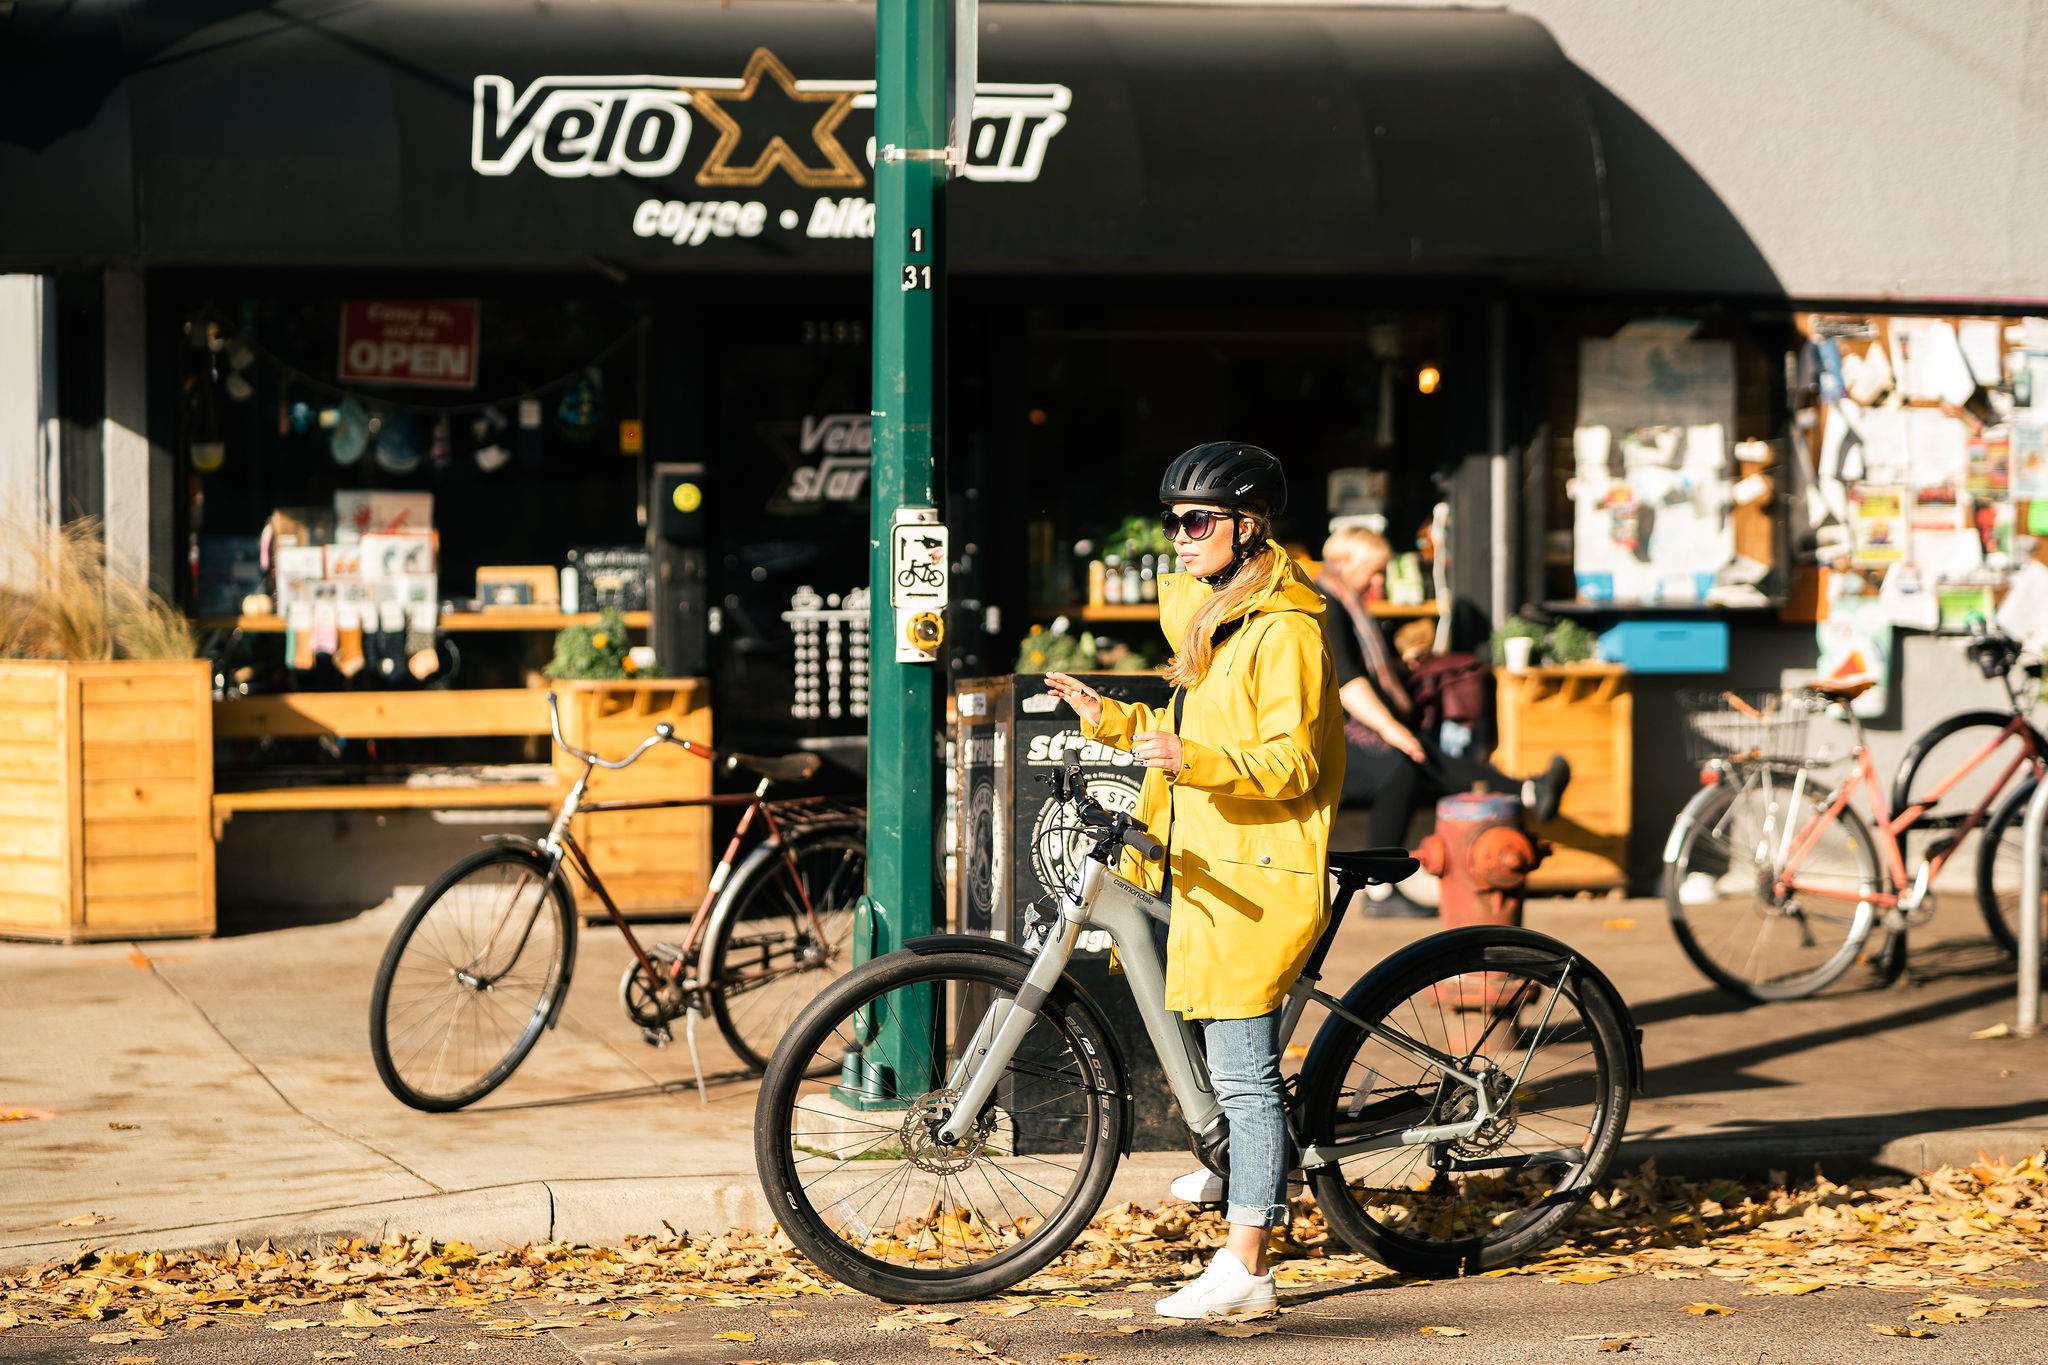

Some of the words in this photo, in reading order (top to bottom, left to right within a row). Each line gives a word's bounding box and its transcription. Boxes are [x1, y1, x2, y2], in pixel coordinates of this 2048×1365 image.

[472, 74, 746, 178] Velo
[633, 199, 767, 246] coffee
[806, 197, 876, 238] bik
[911, 228, 922, 252] 1
[903, 265, 931, 290] 31
[350, 339, 468, 375] OPEN
[801, 414, 871, 453] Velo
[1026, 730, 1135, 767] straig
[1113, 879, 1155, 905] cannondale
[1588, 1085, 1623, 1175] SCHWALBE
[797, 1213, 870, 1277] SCHWALBE
